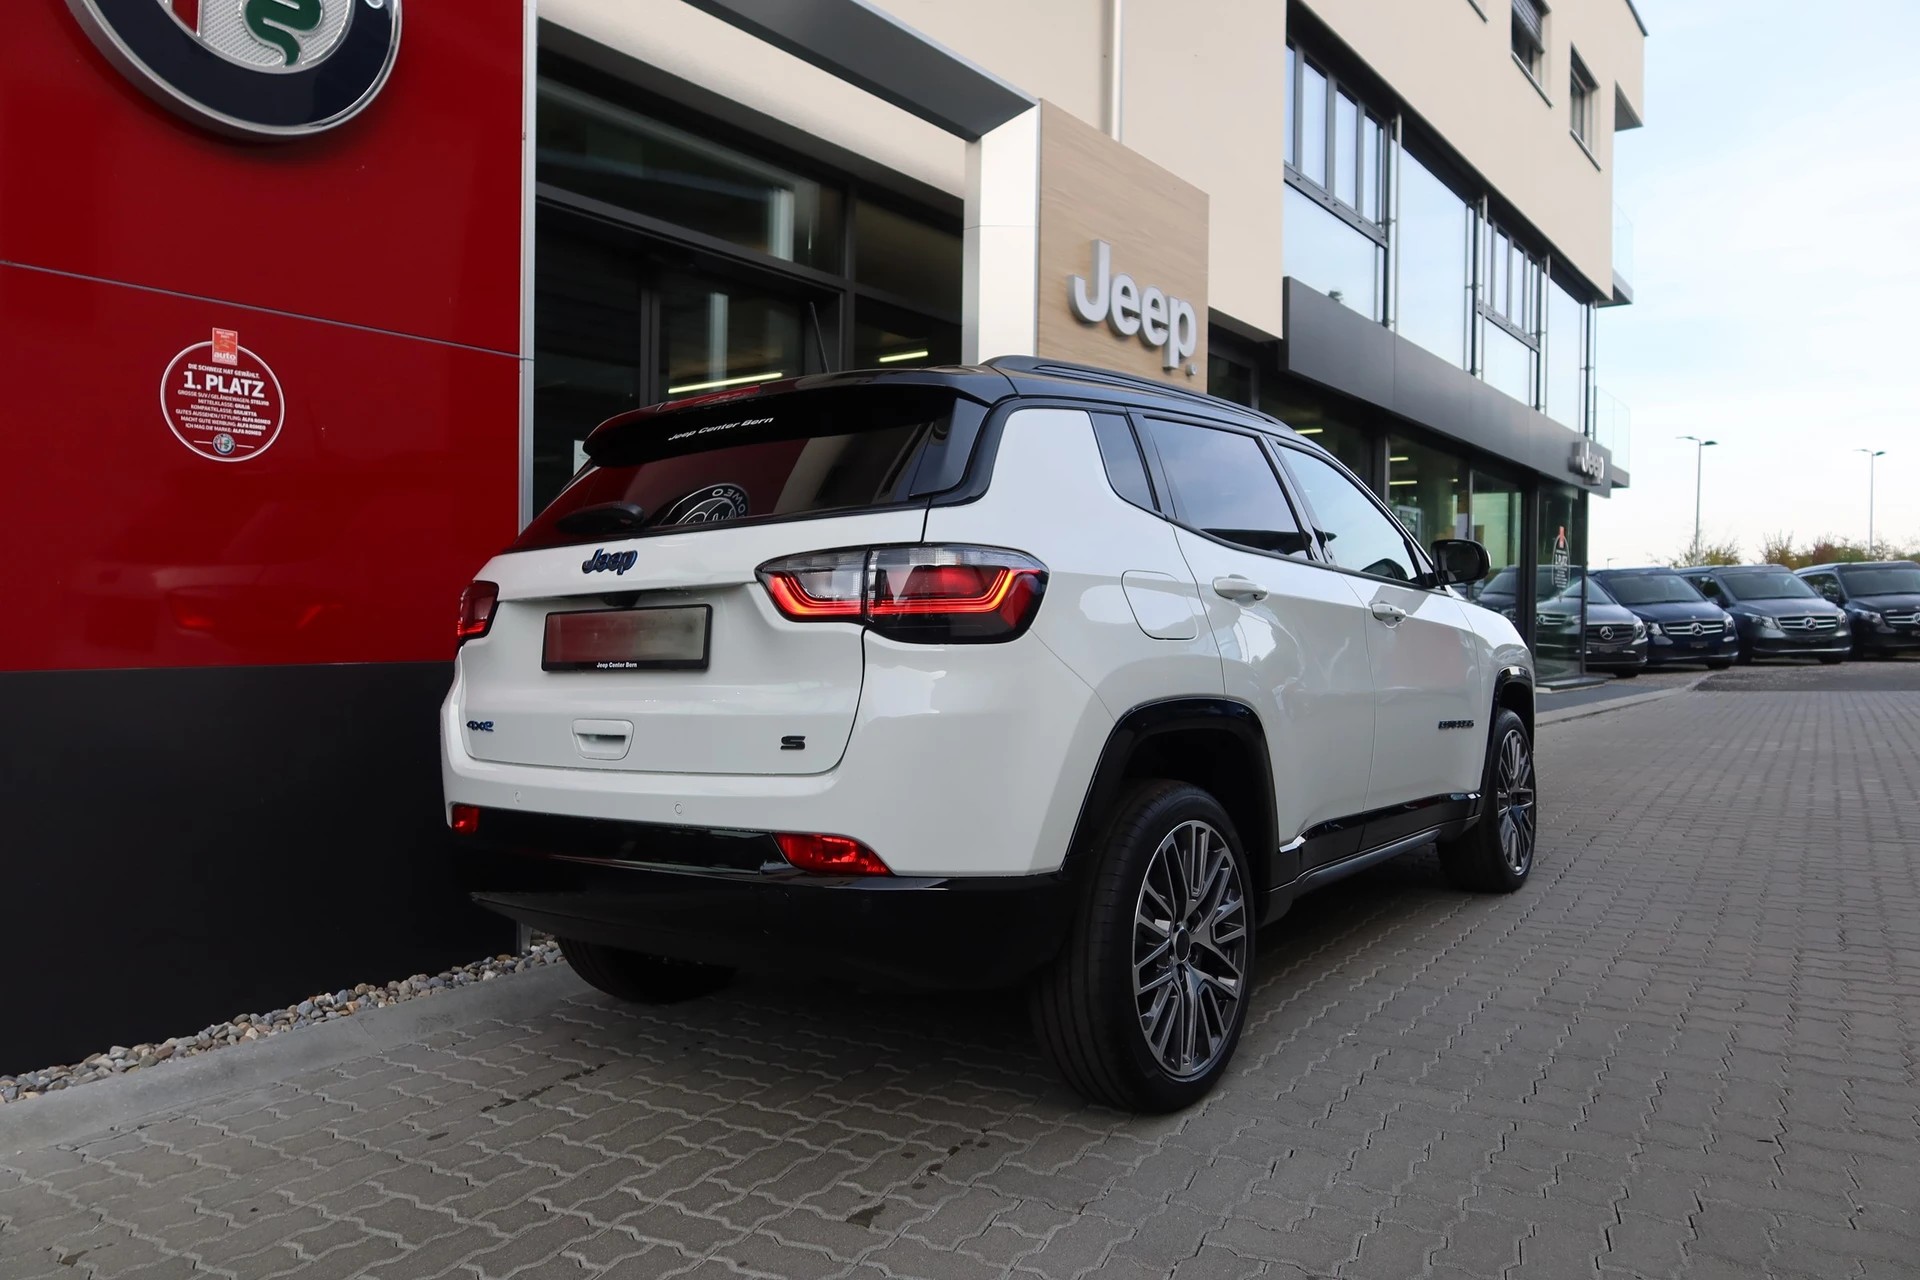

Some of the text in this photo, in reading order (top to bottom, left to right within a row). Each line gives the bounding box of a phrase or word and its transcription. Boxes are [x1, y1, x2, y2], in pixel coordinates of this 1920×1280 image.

[1067, 239, 1197, 369] Jeep
[213, 352, 236, 360] auto
[198, 364, 222, 373] SCHWEIZ
[184, 371, 264, 398] 1. PLATZ
[668, 417, 774, 440] Jeep Center Bern
[582, 548, 638, 576] Jeep
[780, 735, 806, 751] S
